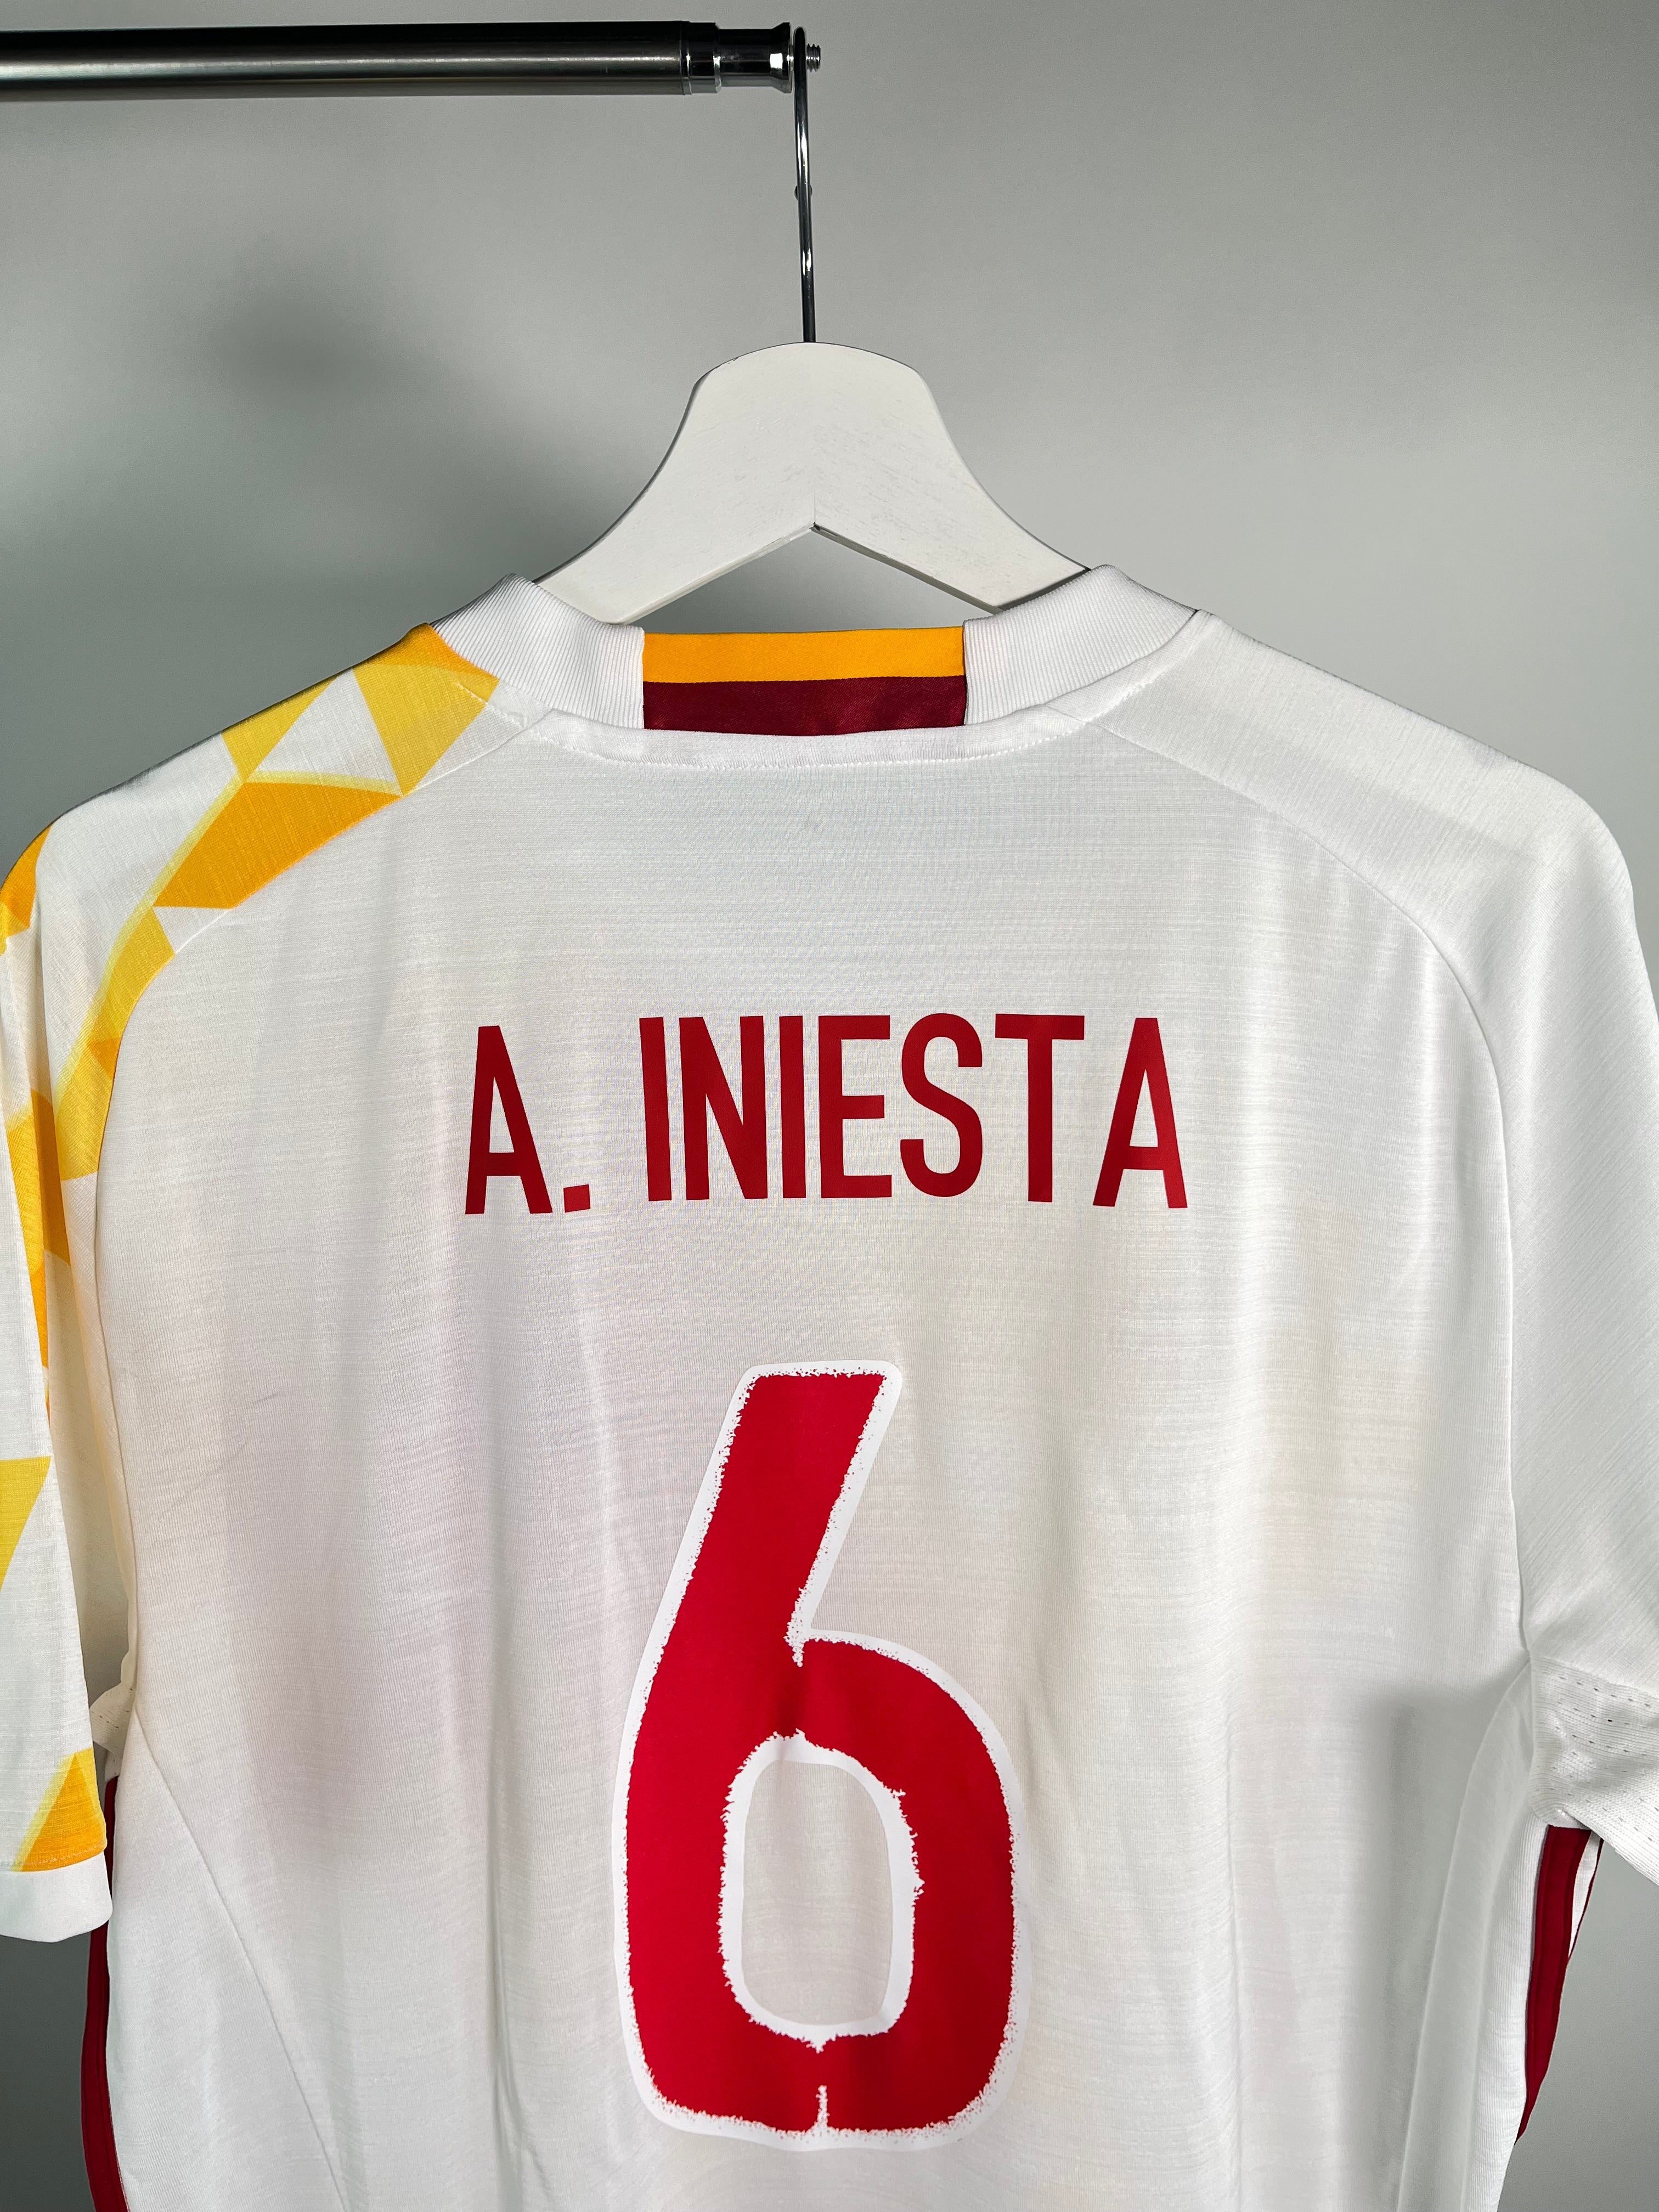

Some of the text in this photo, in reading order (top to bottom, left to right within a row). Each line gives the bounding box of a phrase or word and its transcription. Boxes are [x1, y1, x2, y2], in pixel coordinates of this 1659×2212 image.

[466, 1013, 1188, 1215] A. INIESTA
[620, 1367, 1019, 2137] 6
